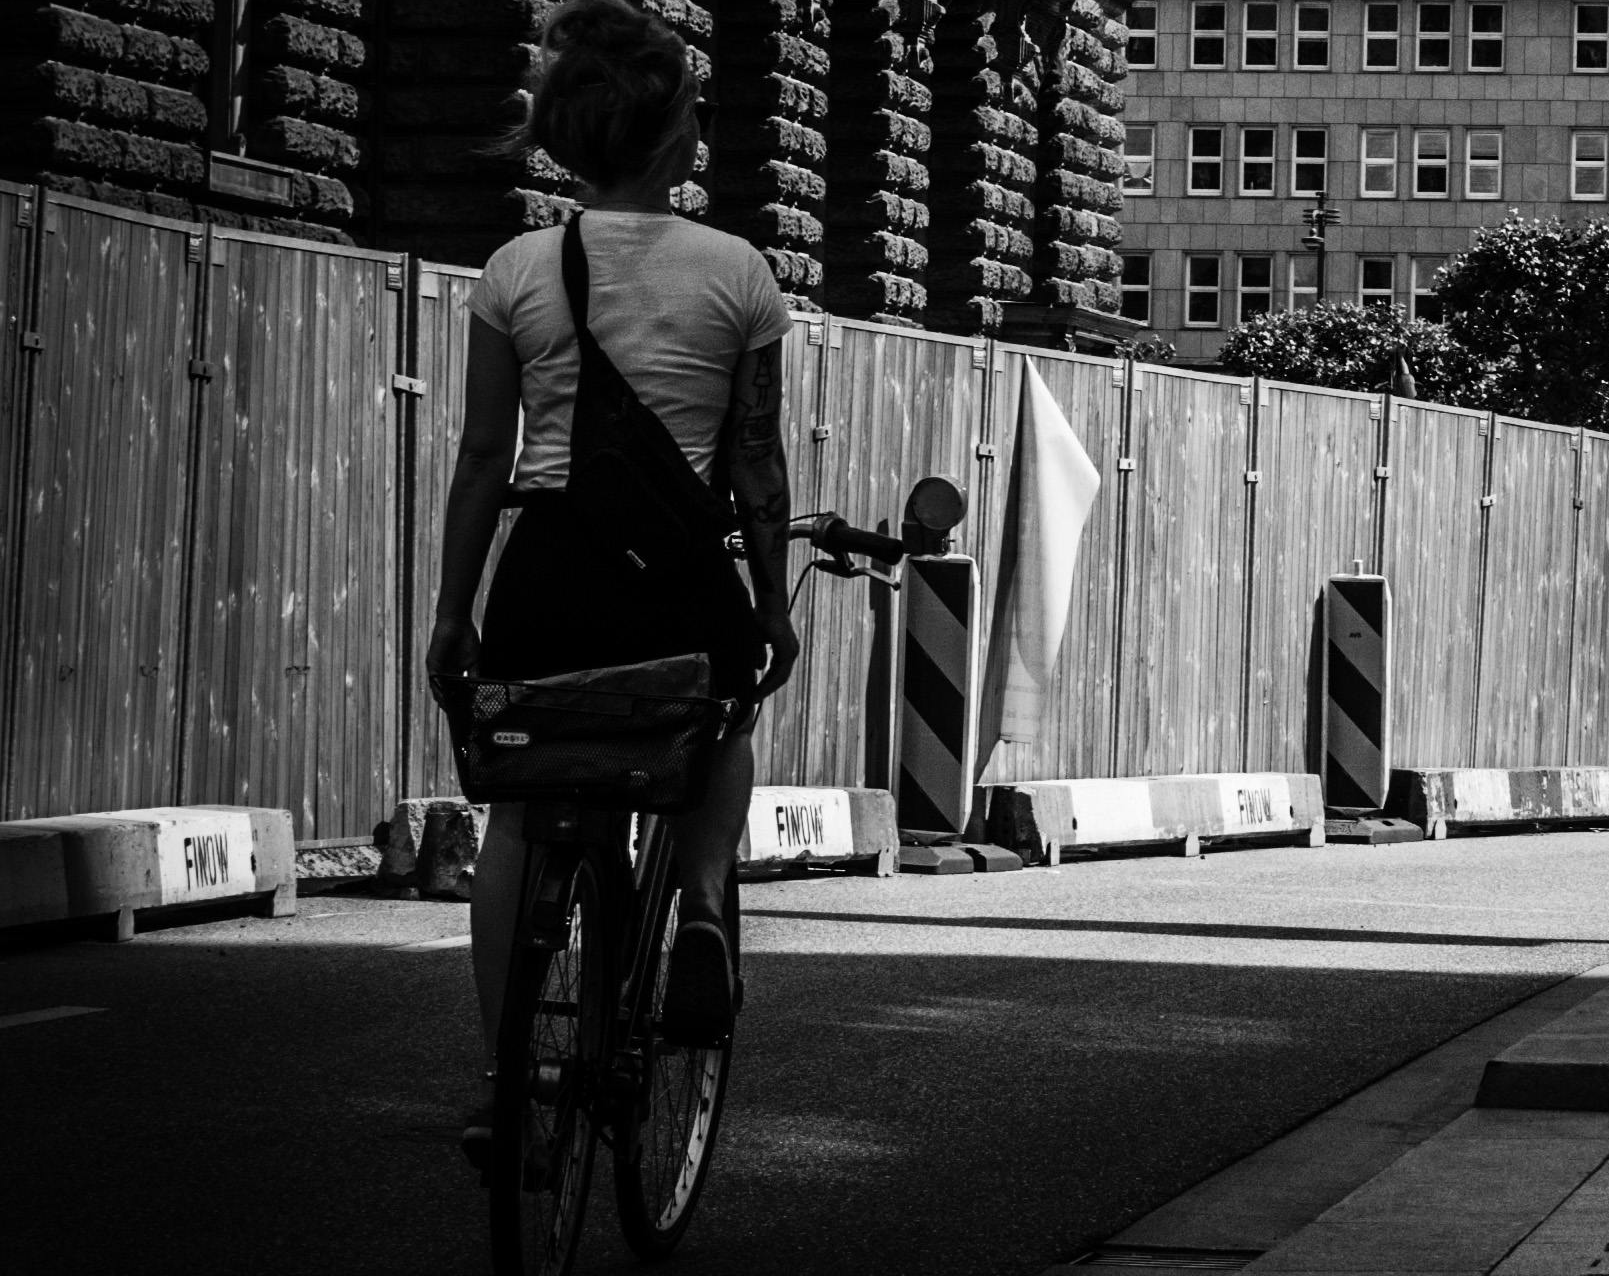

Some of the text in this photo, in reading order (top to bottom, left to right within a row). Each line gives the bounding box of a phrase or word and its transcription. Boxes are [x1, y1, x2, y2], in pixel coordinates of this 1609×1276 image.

[776, 804, 824, 847] FINOW
[1237, 788, 1273, 826] FINOW
[184, 830, 229, 892] FINOW
